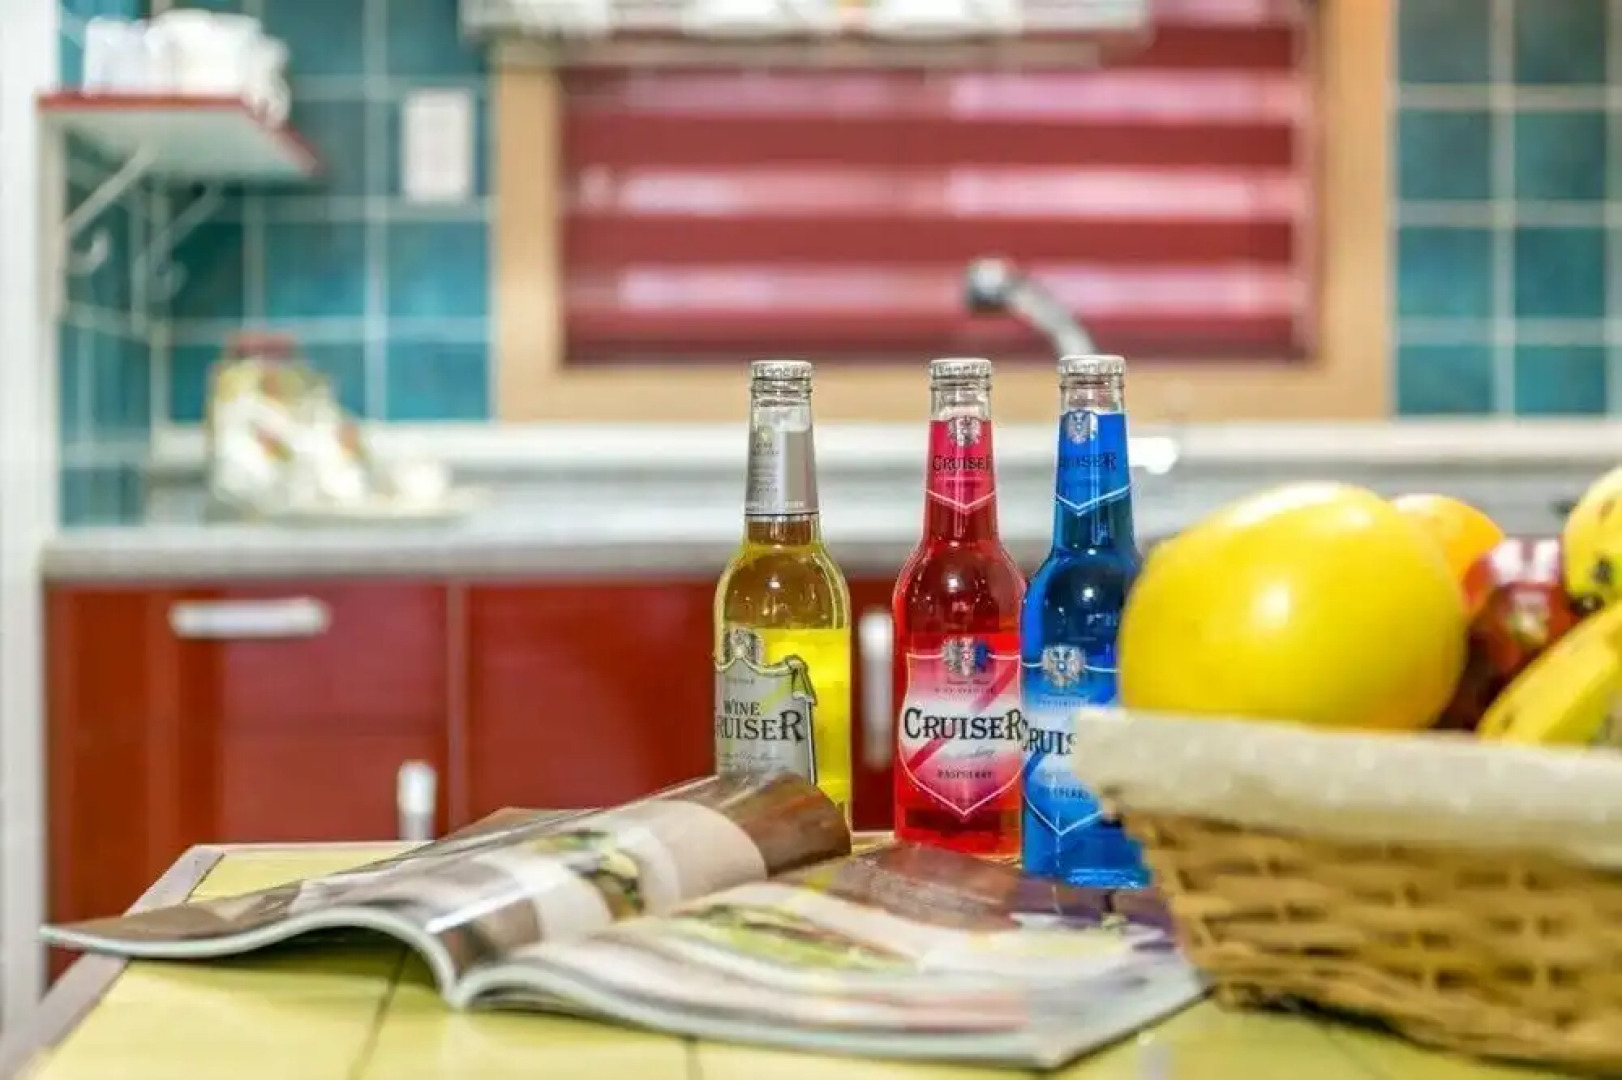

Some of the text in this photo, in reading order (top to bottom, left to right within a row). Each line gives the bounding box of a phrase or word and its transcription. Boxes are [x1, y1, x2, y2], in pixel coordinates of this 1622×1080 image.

[724, 699, 760, 716] WINE
[904, 707, 1024, 741] CRUISER
[716, 709, 806, 744] RUISER
